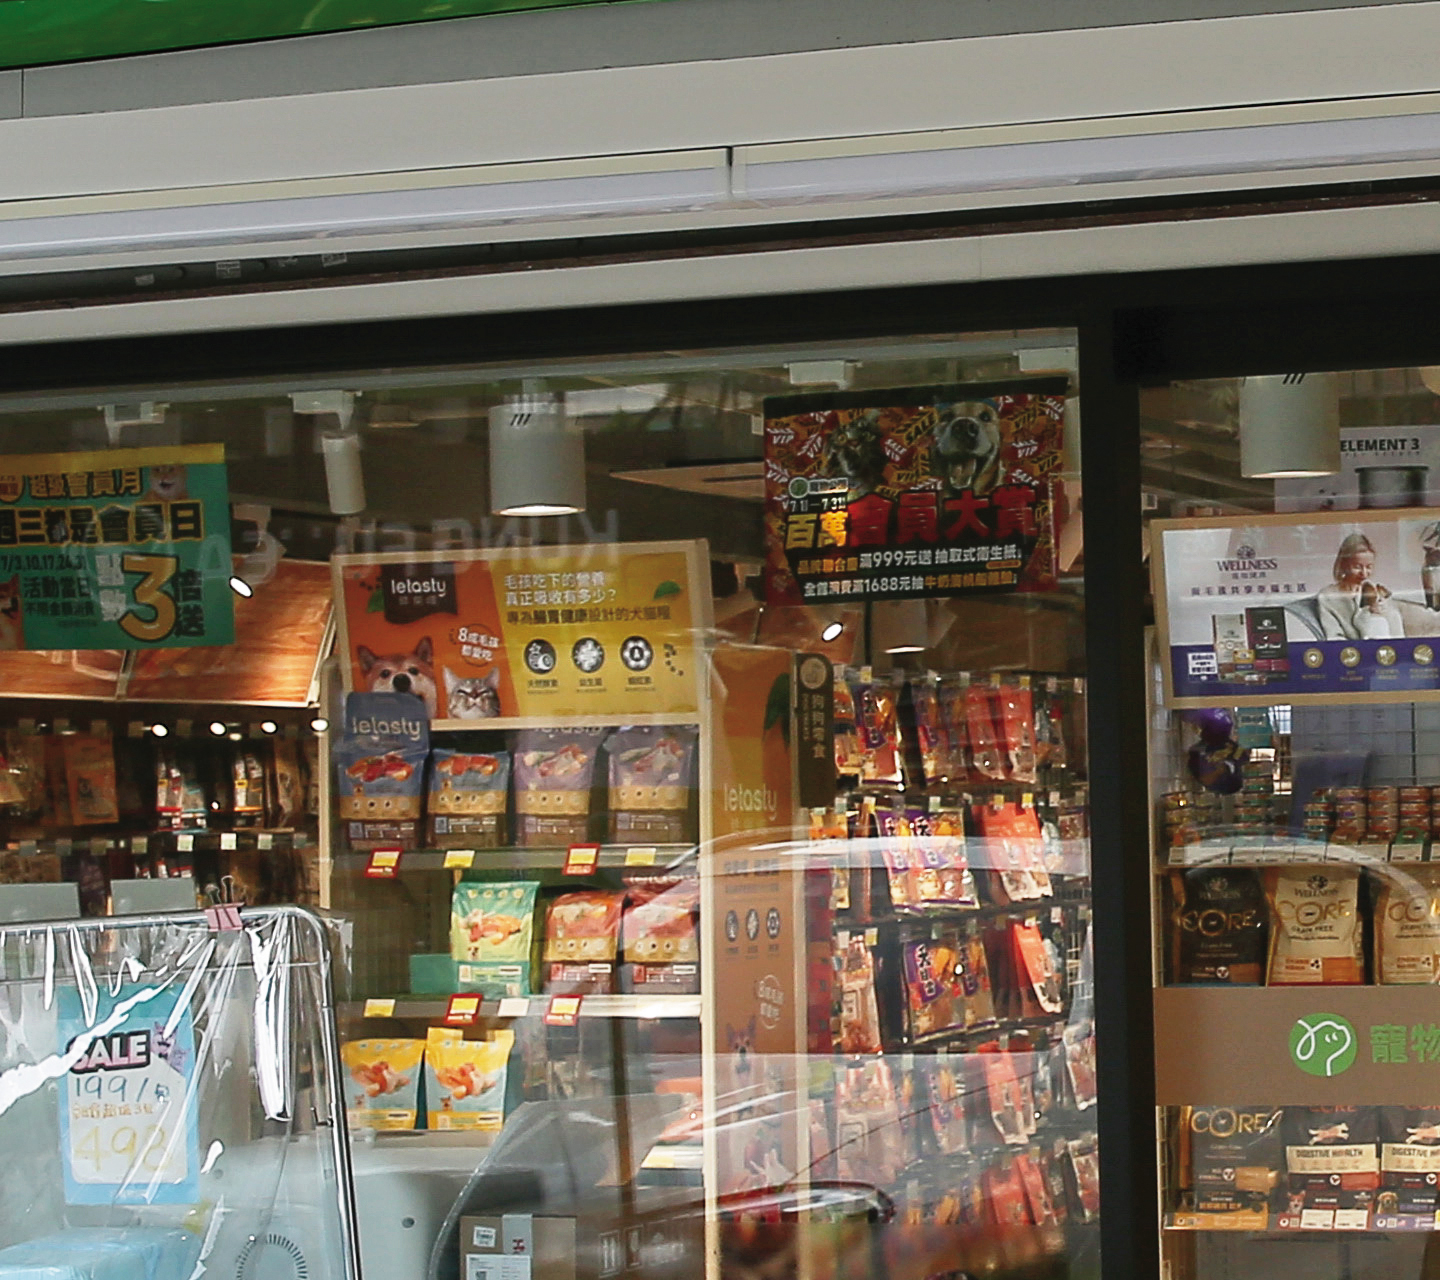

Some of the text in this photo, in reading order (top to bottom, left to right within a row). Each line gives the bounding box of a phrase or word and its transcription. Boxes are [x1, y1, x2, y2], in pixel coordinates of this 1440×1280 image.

[1339, 437, 1420, 453] ELEMENT 3
[1216, 558, 1278, 572] WELLNESS
[391, 577, 447, 598] letasty
[504, 573, 605, 590] 毛孩吃下的營養
[118, 553, 179, 641] 3
[352, 715, 421, 740] letasty
[723, 782, 778, 819] letasty
[73, 1033, 149, 1070] SALE
[1190, 1106, 1270, 1139] CORE
